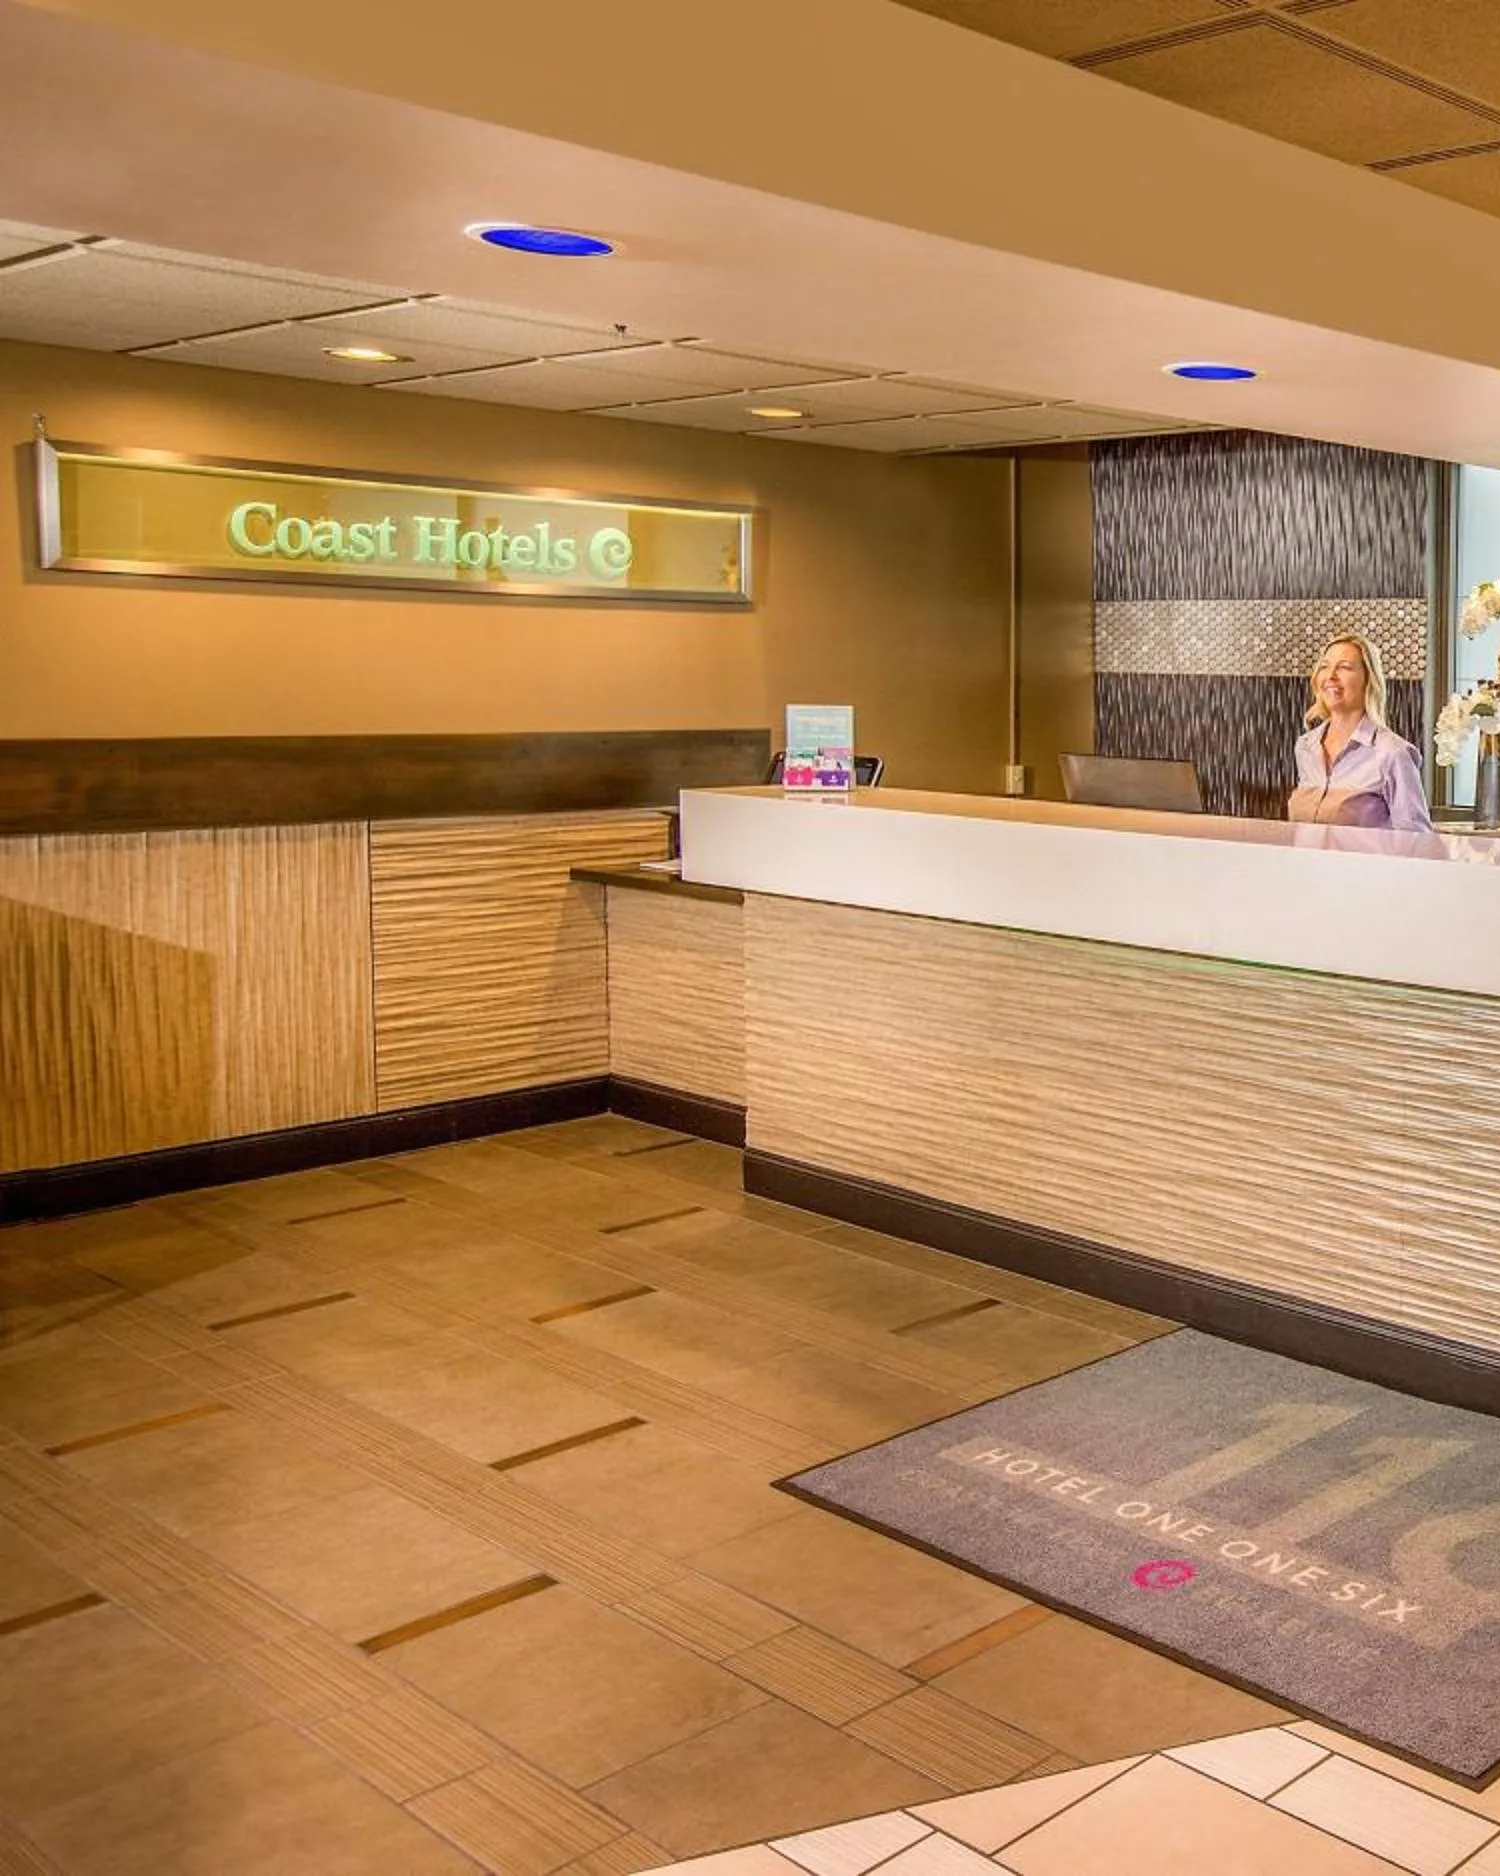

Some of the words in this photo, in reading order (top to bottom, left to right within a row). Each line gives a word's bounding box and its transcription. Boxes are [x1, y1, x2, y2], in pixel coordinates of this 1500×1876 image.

[229, 500, 398, 560] Coast
[413, 515, 576, 572] Hotels
[972, 1447, 1104, 1504] HOTEL
[1114, 1500, 1214, 1543] ONE
[1219, 1541, 1329, 1587] ONE
[1330, 1582, 1424, 1623] SIX
